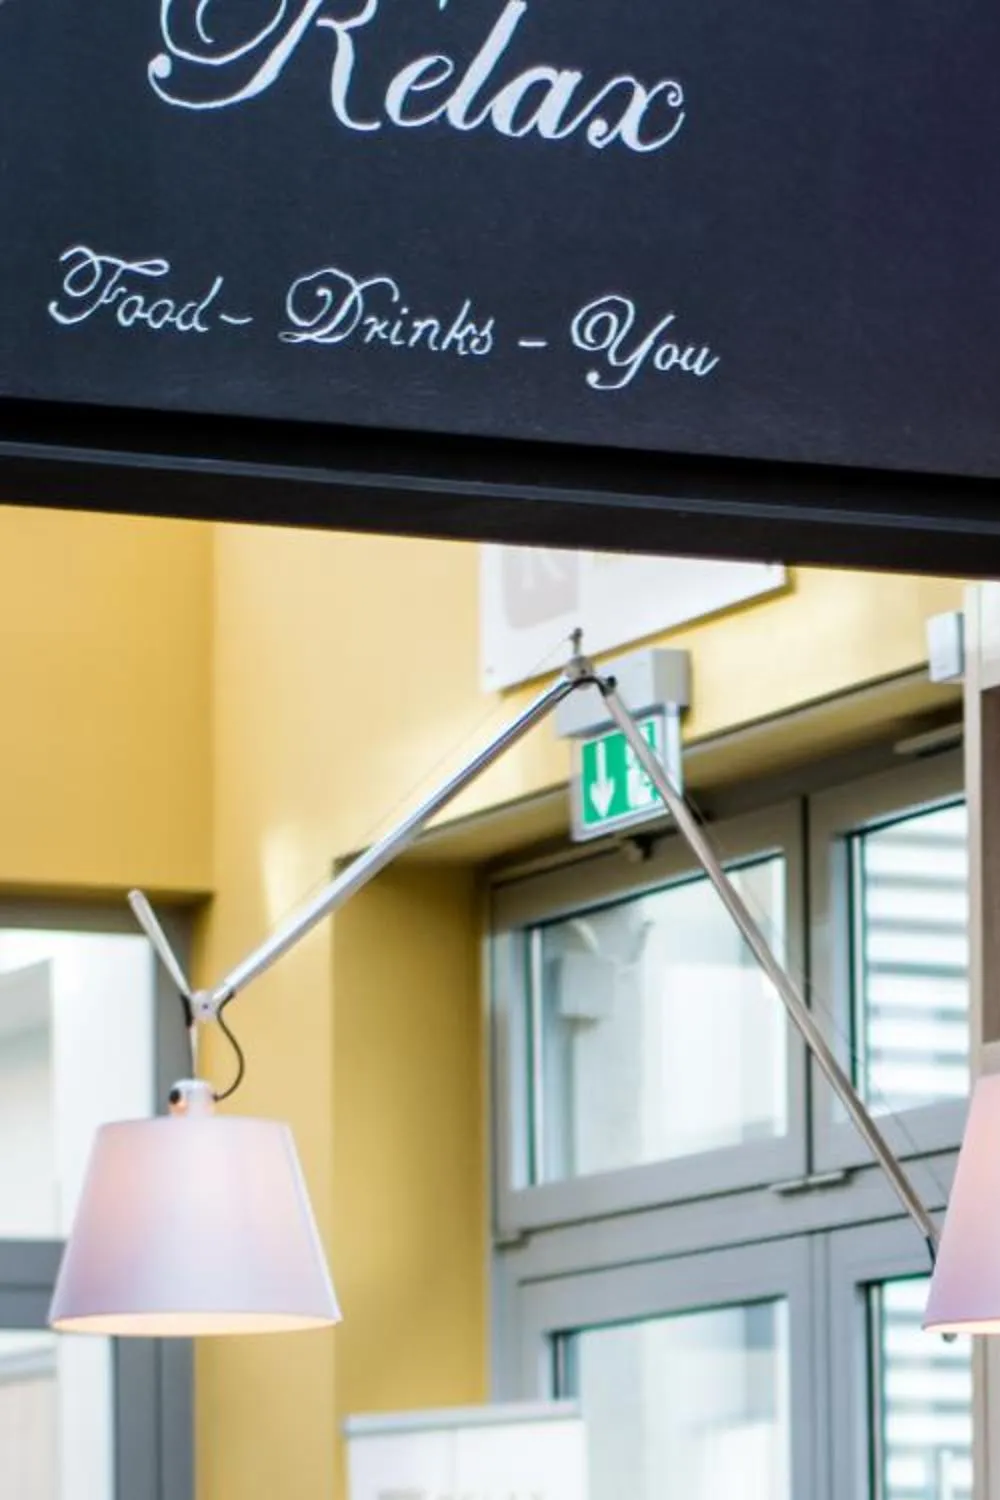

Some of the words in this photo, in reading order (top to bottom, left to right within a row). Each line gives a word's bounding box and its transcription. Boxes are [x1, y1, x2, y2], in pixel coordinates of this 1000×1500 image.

[148, 0, 685, 152] Relax
[280, 268, 494, 355] Drinks
[571, 295, 719, 389] You
